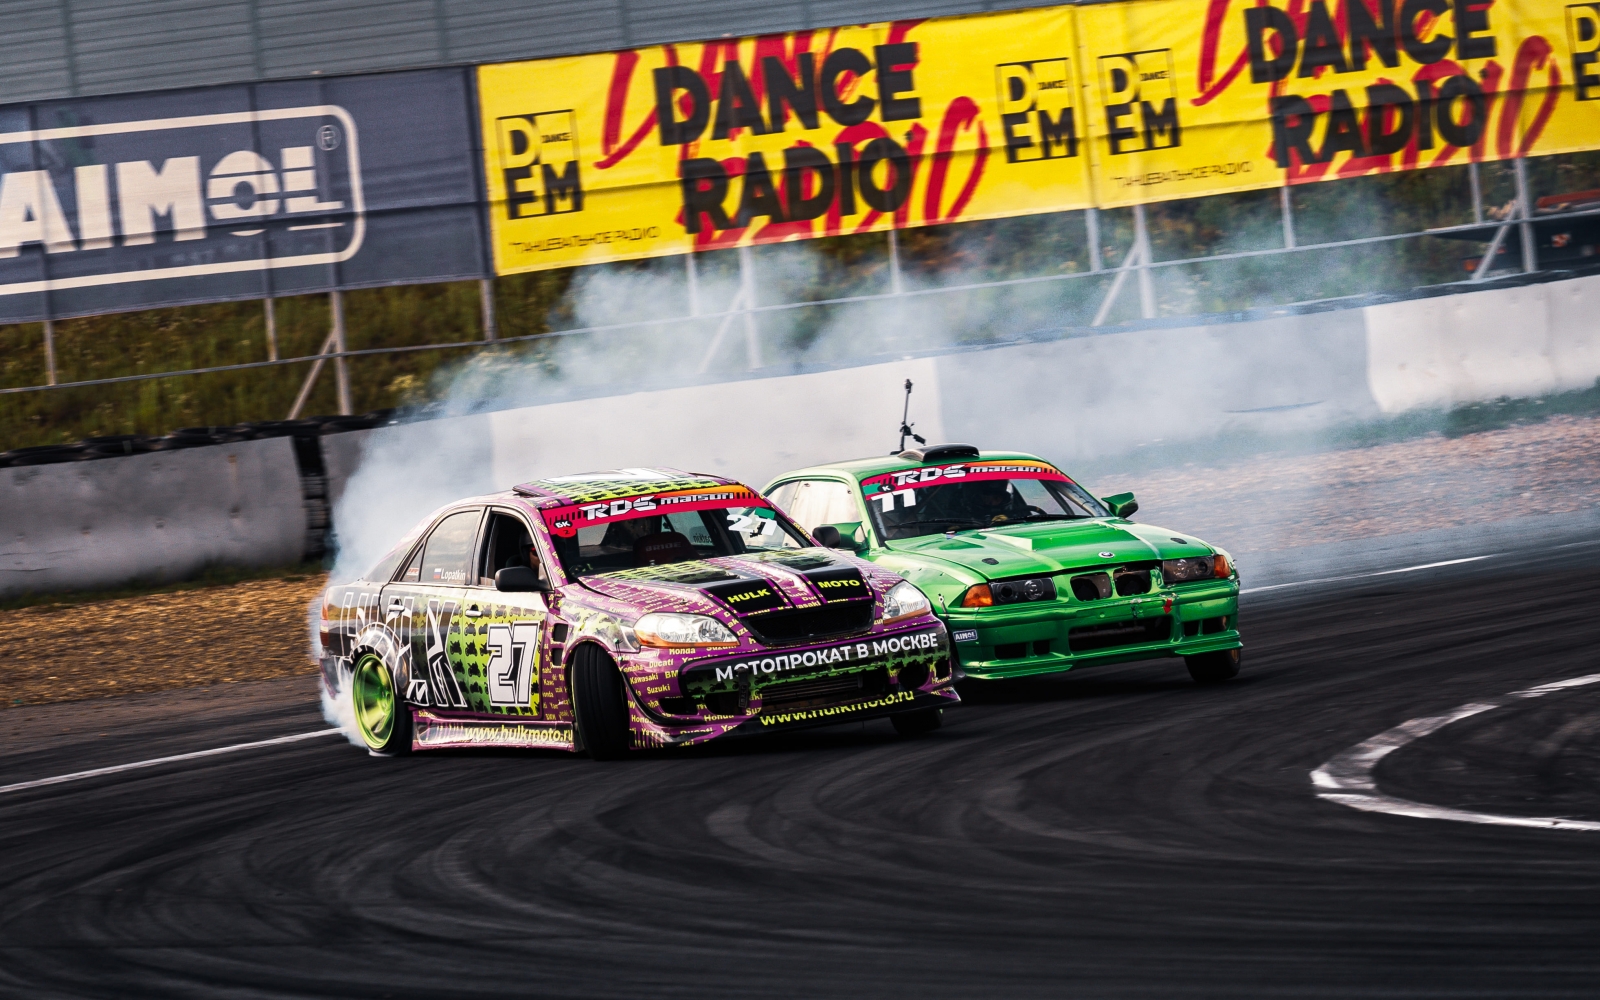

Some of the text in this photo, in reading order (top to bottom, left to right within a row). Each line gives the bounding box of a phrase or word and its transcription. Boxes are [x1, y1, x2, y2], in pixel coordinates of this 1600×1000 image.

[1243, 0, 1497, 84] DANCE
[653, 41, 922, 147] DANCE
[1269, 74, 1486, 169] RADIO
[680, 136, 912, 234] RADIO
[0, 146, 344, 258] AIMOL
[891, 464, 966, 486] RDS
[579, 495, 657, 521] RDS
[870, 488, 916, 513] 77
[440, 568, 466, 582] Lopatkin
[817, 579, 861, 589] MOTO
[727, 588, 771, 604] HULK
[857, 642, 869, 659] В
[872, 632, 939, 656] МОСКВЕ
[955, 631, 976, 641] AIMOL
[669, 647, 696, 656] Honda
[487, 620, 541, 707] 27
[649, 658, 674, 668] Ducati
[629, 673, 659, 684] Kawasaki
[665, 670, 679, 679] BM
[646, 684, 671, 694] Suzuki
